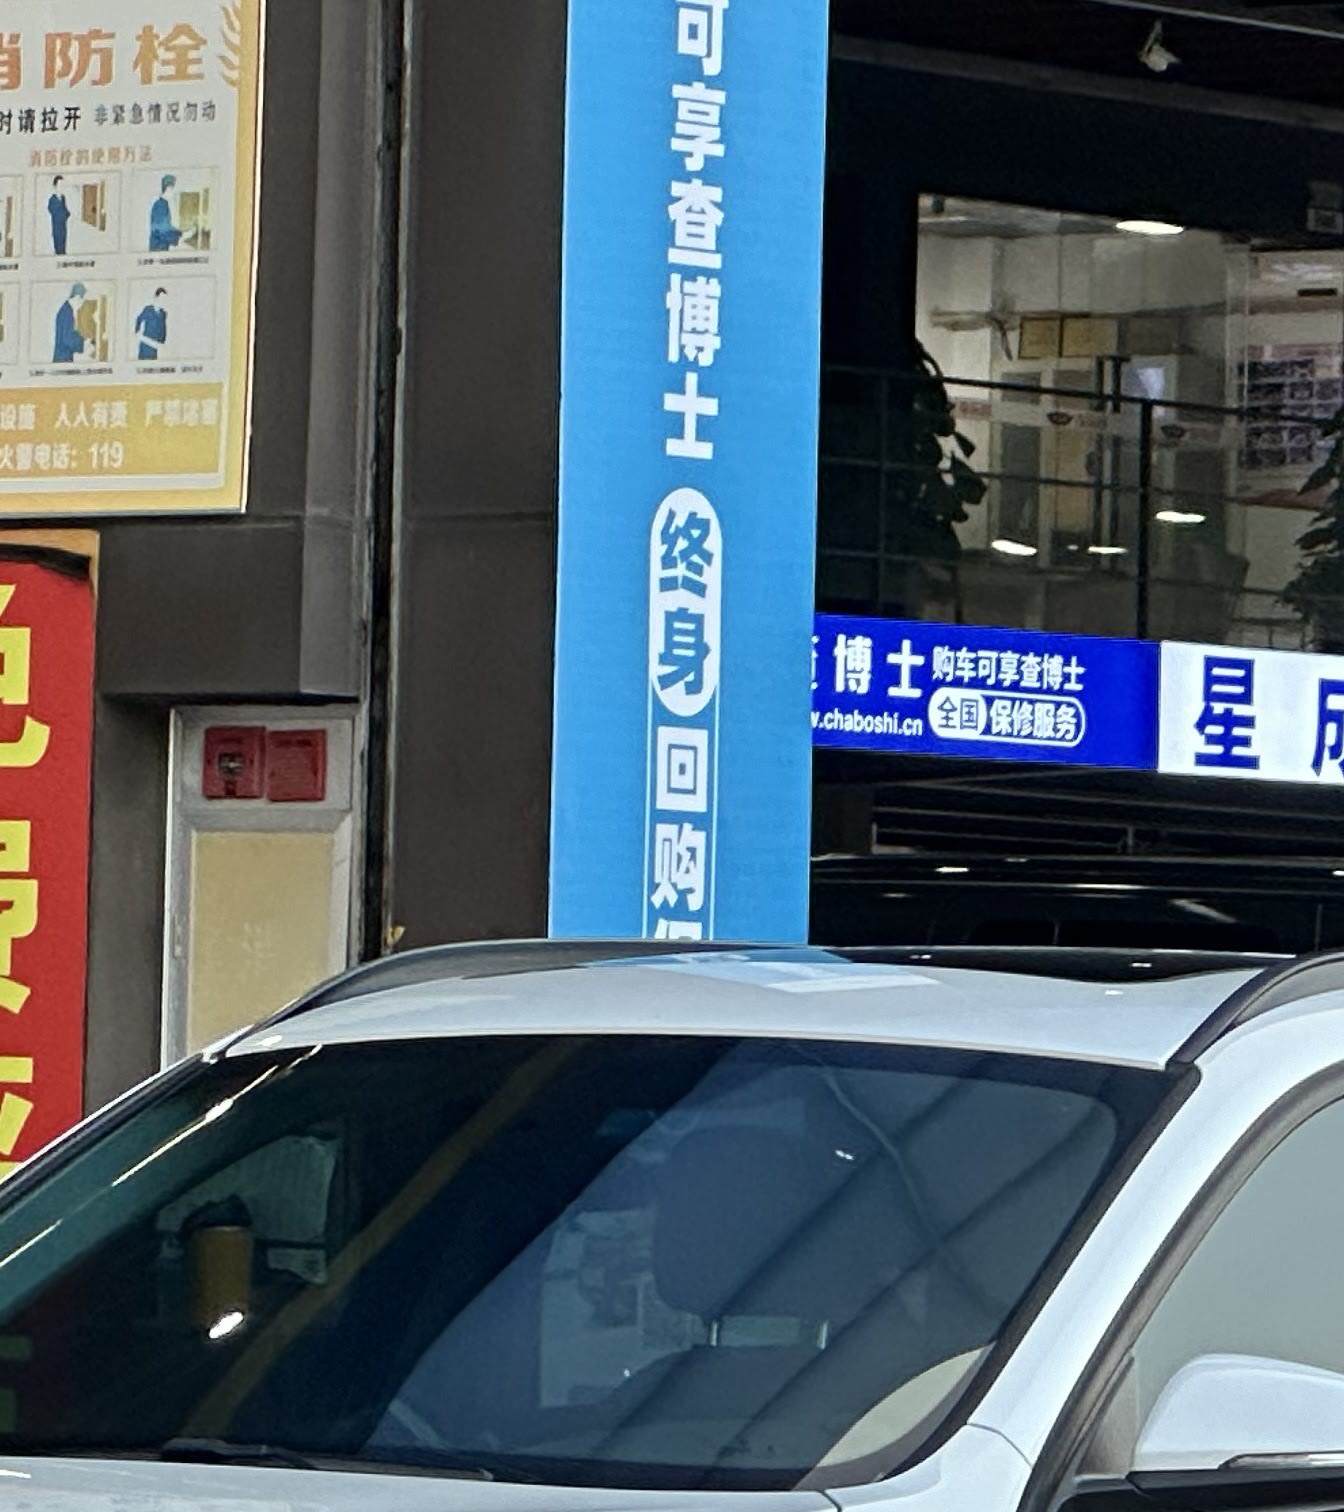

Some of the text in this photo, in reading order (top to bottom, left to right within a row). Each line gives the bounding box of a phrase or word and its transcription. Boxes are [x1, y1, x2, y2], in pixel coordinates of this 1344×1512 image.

[657, 508, 715, 698] 终身
[811, 633, 926, 699] 博士
[931, 644, 1086, 692] 购车可享查博士
[935, 696, 1079, 741] 全国 保修服务
